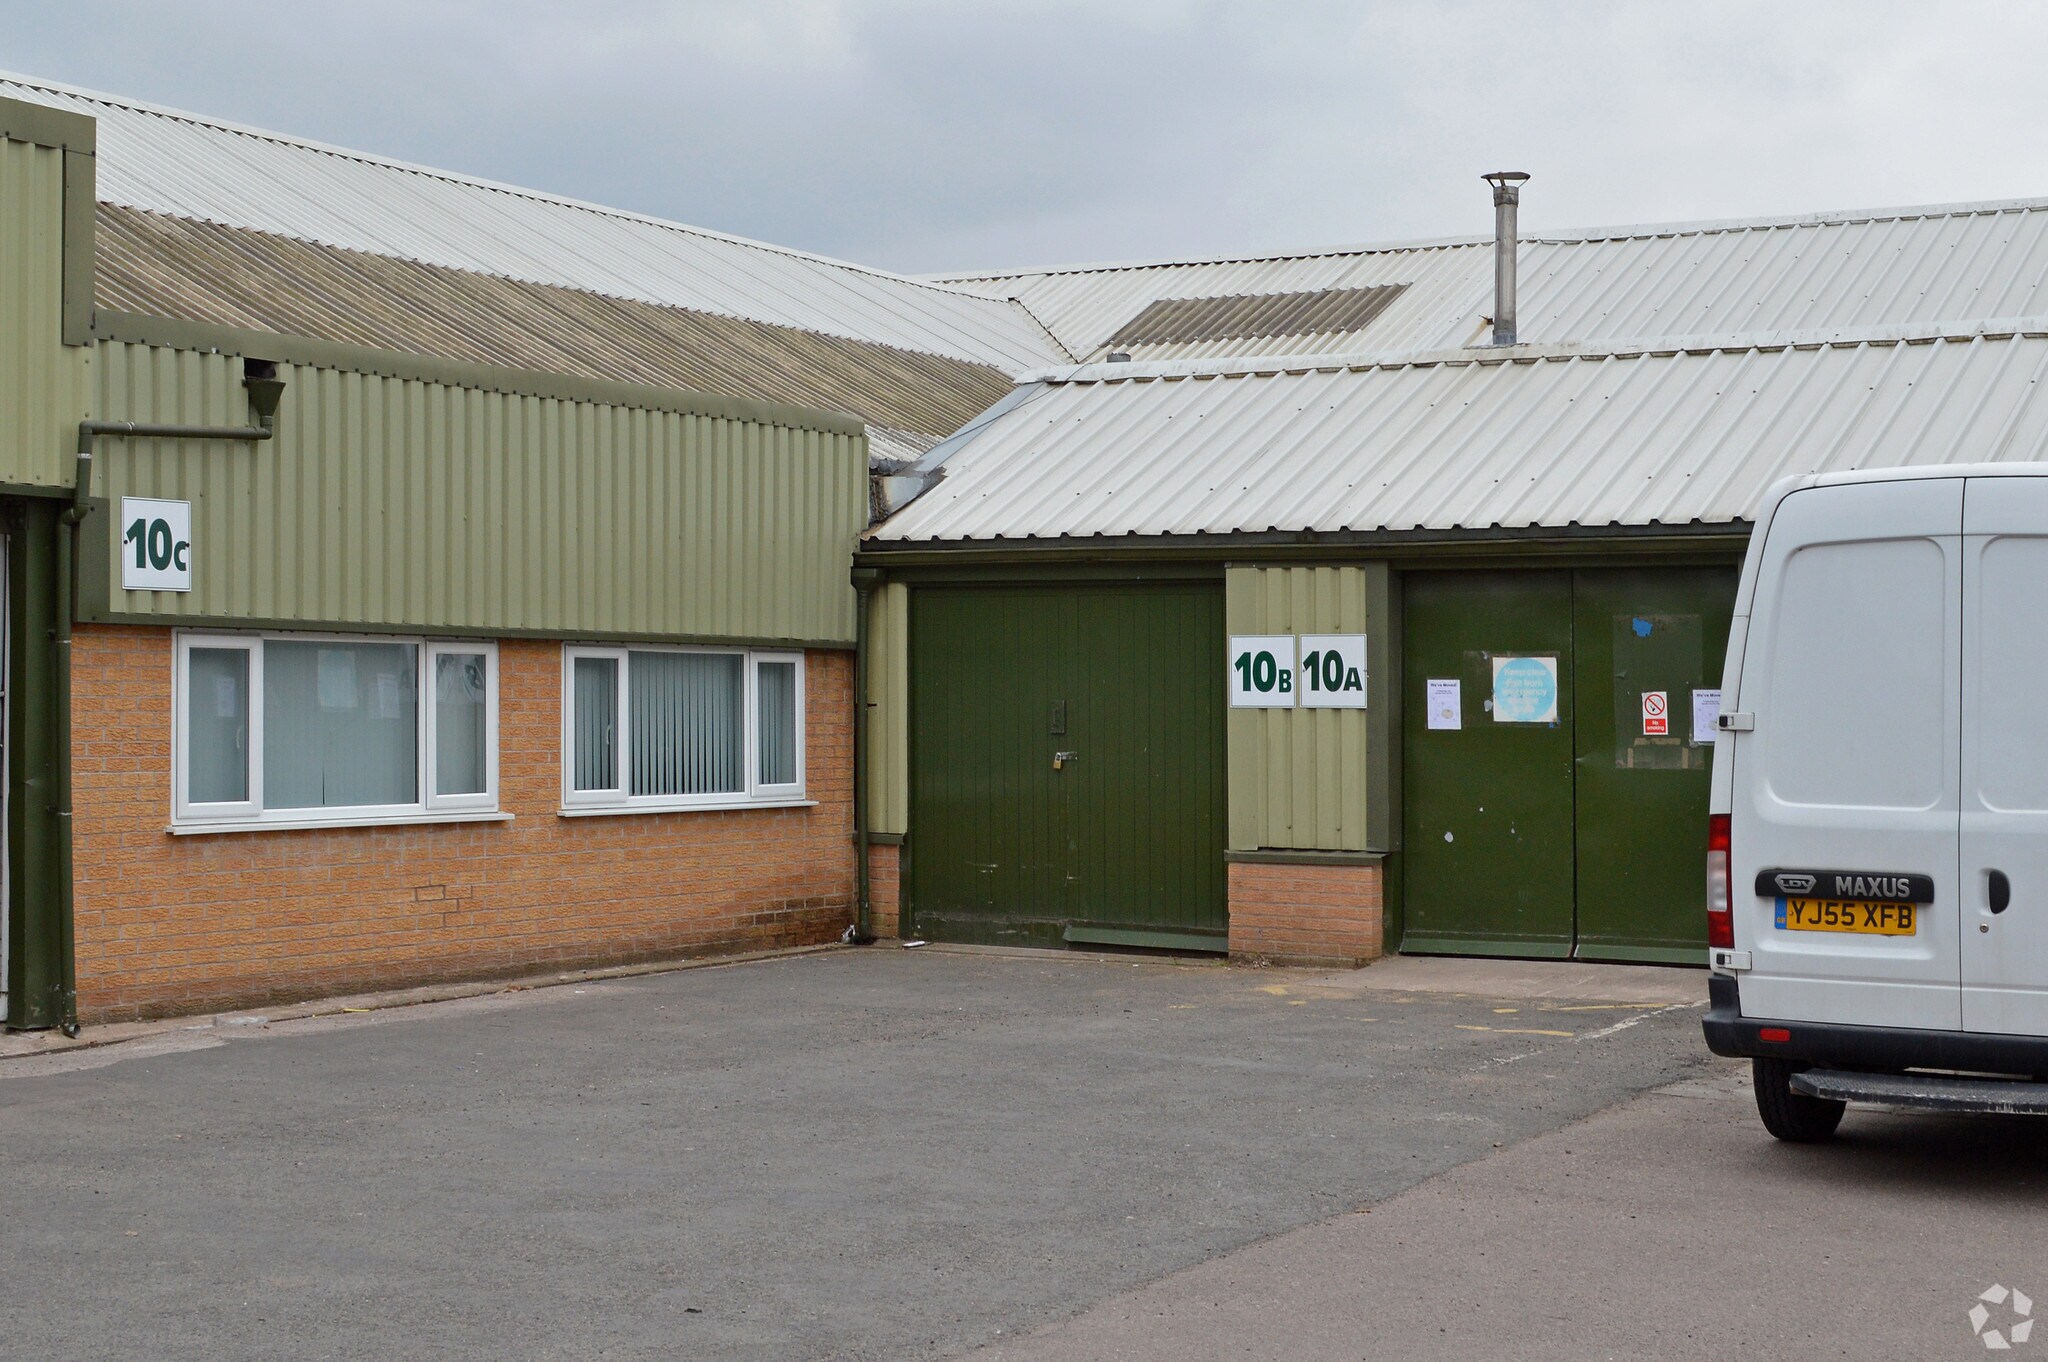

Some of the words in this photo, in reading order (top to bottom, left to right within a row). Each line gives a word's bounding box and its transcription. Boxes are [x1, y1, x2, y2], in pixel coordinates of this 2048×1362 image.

[1234, 650, 1292, 693] 10B
[1303, 649, 1363, 692] 10A
[1835, 876, 1911, 898] MAXUS
[1792, 900, 1856, 926] YJ55
[1863, 903, 1912, 929] XFB
